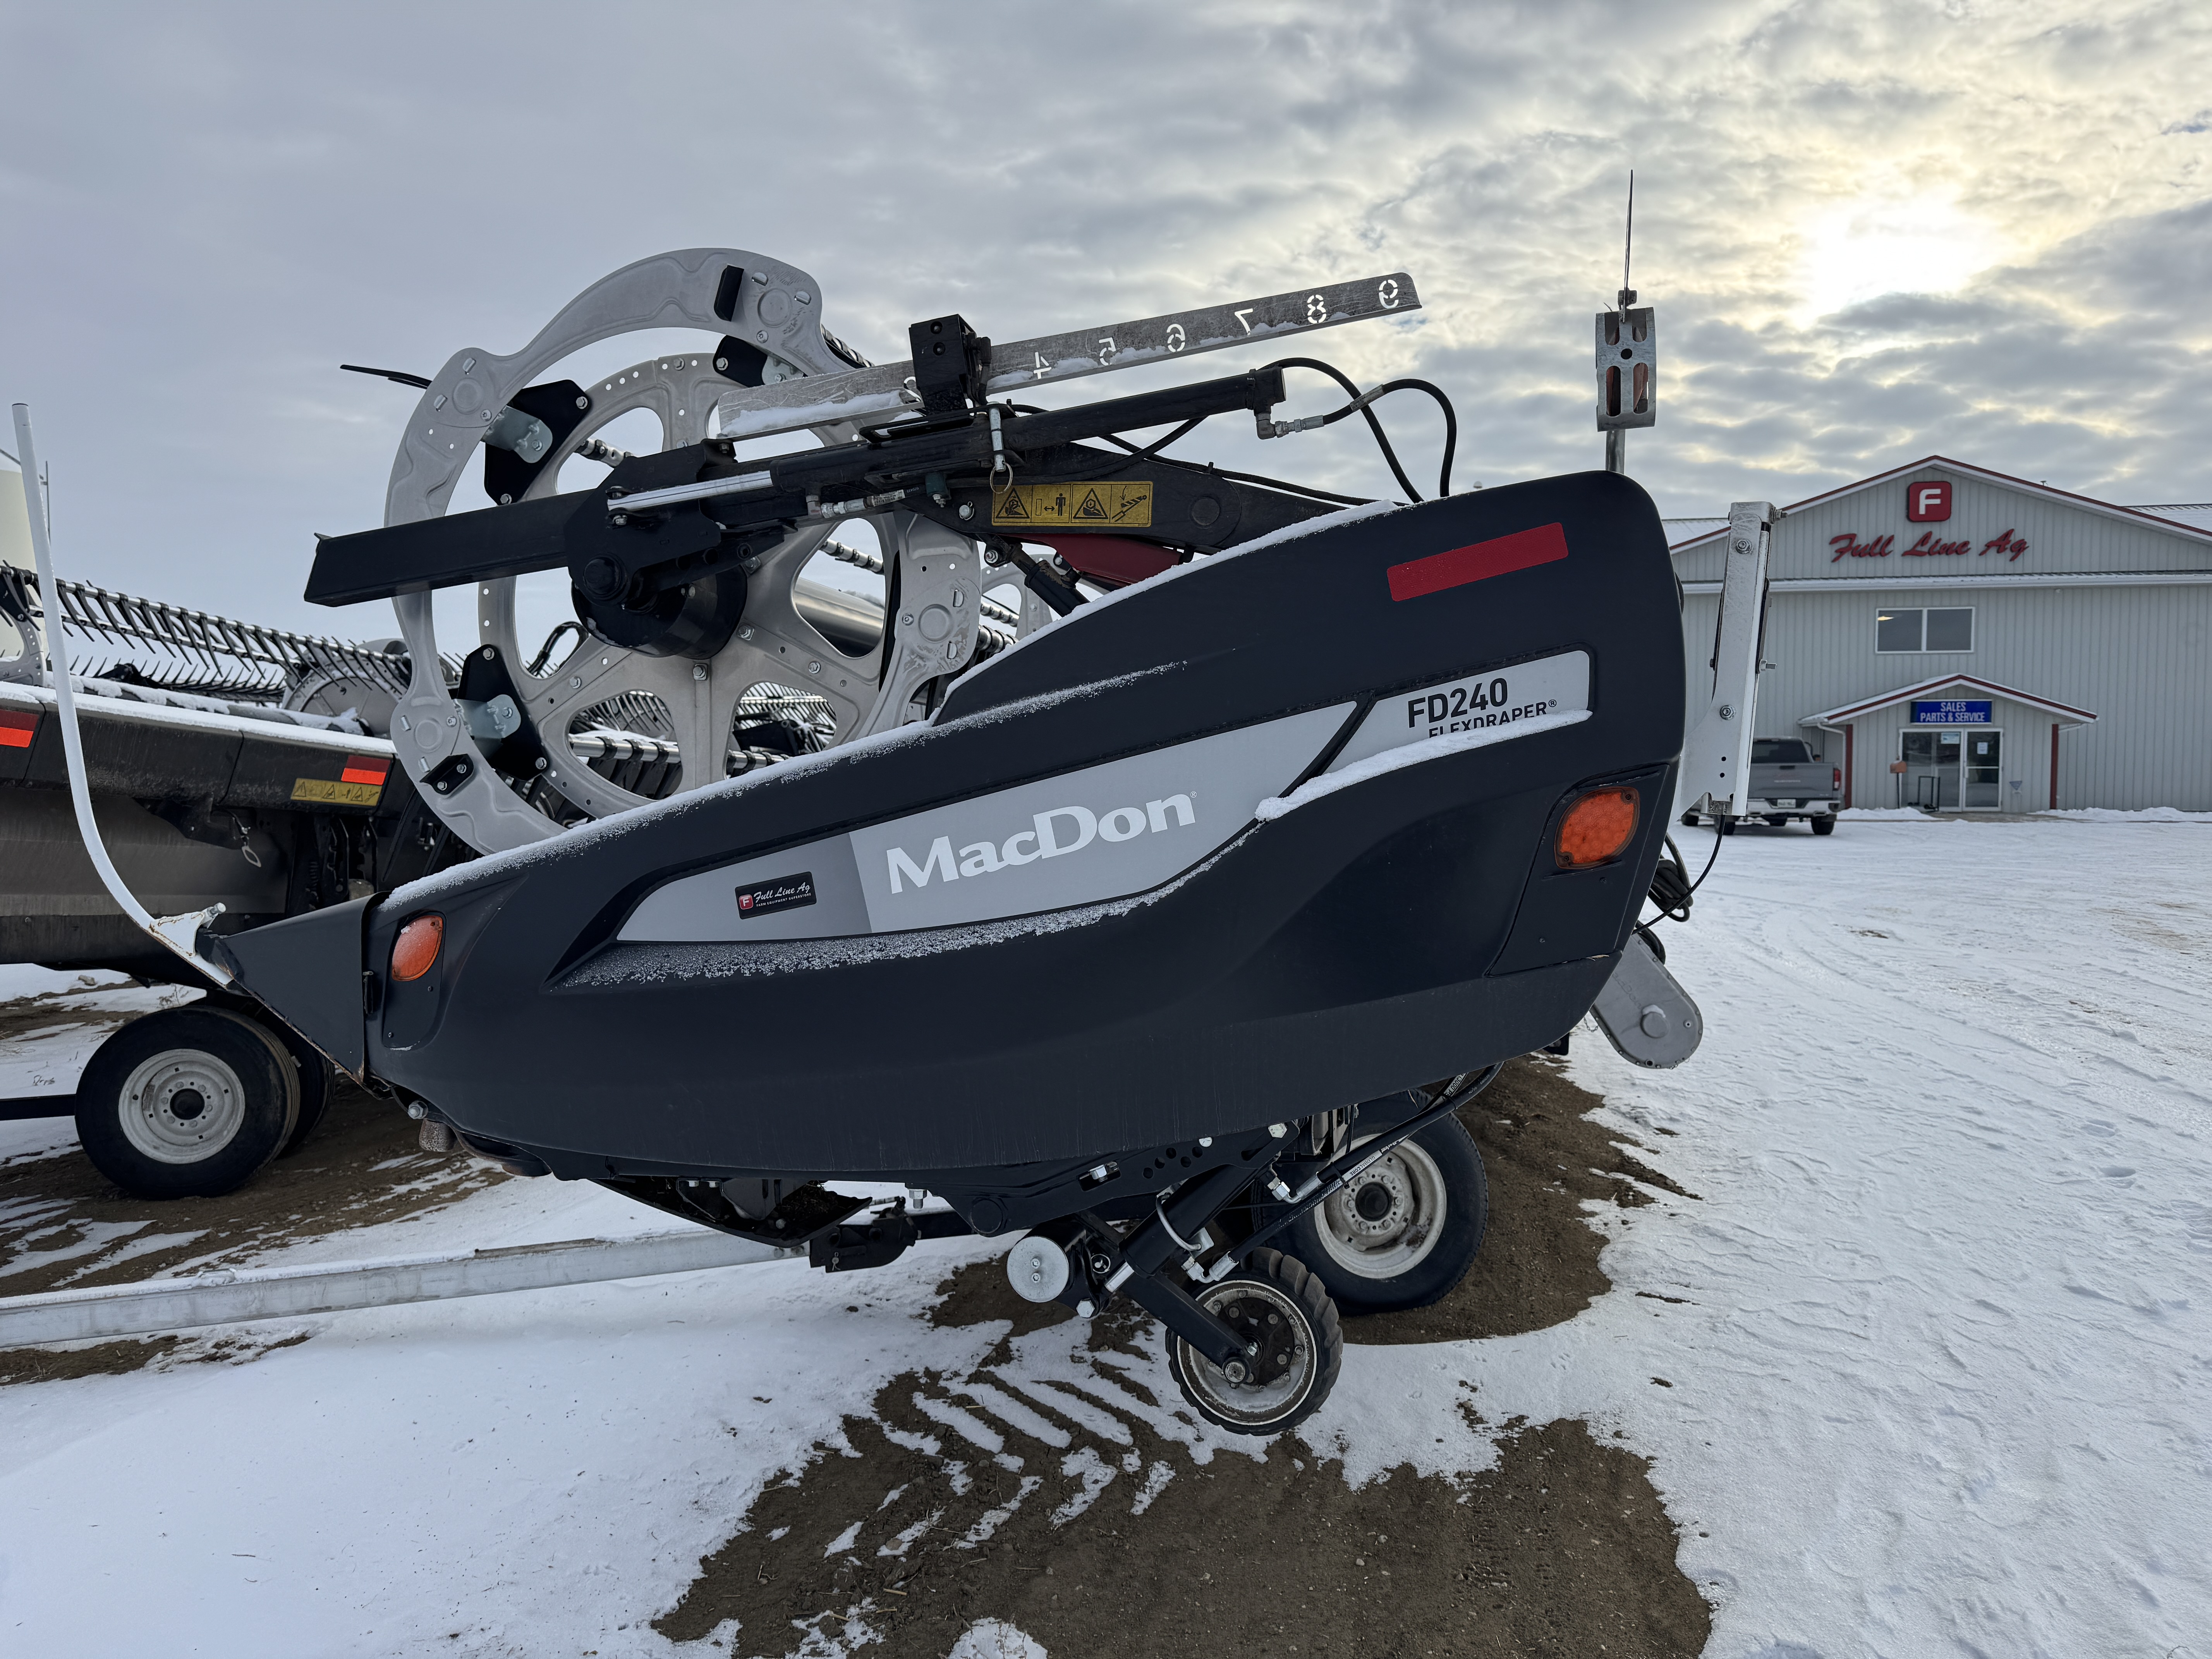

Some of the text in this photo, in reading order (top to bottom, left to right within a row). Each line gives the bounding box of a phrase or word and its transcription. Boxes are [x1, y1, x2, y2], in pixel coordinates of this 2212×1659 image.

[1919, 488, 1941, 515] F
[1829, 528, 2029, 563] Full Line Ag
[1408, 678, 1508, 728] FD240
[1941, 702, 1966, 712] SALES
[1920, 712, 1985, 722] PARTS & SERVICE
[754, 882, 811, 903] Full Line Ag
[789, 892, 812, 900] SUPERSTORE
[743, 897, 749, 907] F
